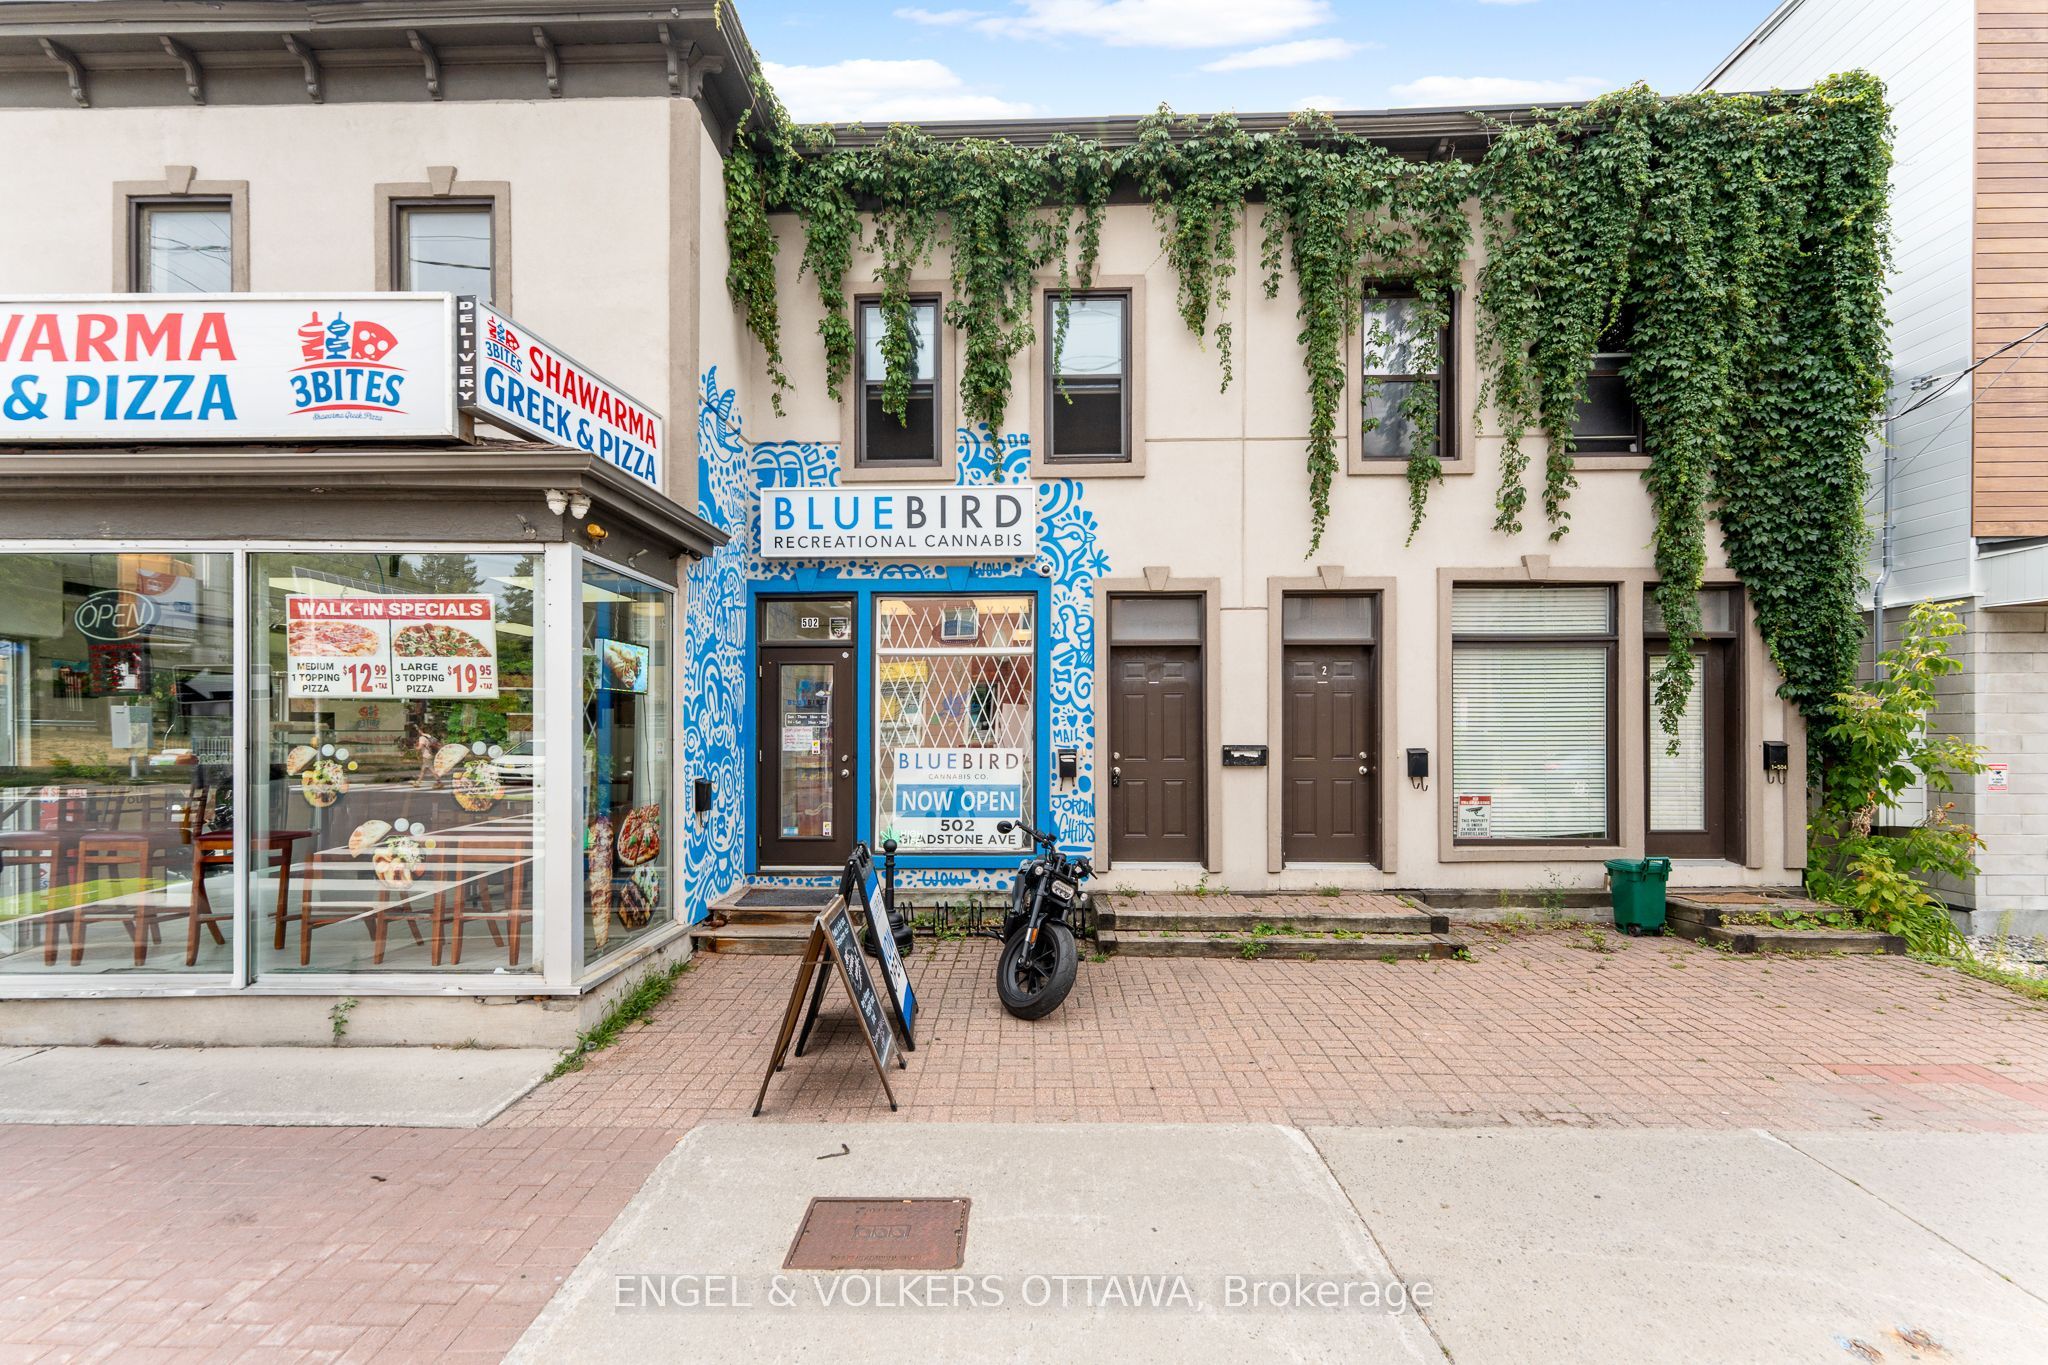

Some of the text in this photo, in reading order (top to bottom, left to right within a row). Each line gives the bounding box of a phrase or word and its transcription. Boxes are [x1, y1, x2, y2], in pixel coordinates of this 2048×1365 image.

[458, 302, 475, 400] DELIVERY
[485, 341, 523, 373] 3BITES
[290, 368, 405, 408] 3BITES
[2, 374, 238, 421] & PIZZA
[529, 346, 656, 449] SHAWARMA
[484, 366, 656, 484] GREEK & PIZZA
[775, 495, 1022, 530] BLUEBIRD
[774, 533, 1022, 549] RECREATIONAL CANNABIS
[79, 603, 146, 628] OPEN
[298, 602, 483, 617] WALK-IN SPECIALS
[802, 618, 818, 628] 502
[297, 662, 334, 671] MEDIUM
[400, 663, 438, 671] LARGE
[1321, 665, 1327, 676] 2
[299, 673, 340, 682] TOPPING
[395, 674, 445, 682] 3 TOPPING
[302, 684, 330, 693] PIZZA
[406, 685, 434, 693] PIZZA
[1053, 729, 1084, 743] MAIL
[899, 753, 1019, 770] BLUEBIRD
[902, 791, 1015, 811] NOW OPEN
[941, 820, 975, 831] 502
[988, 834, 1016, 844] AVE
